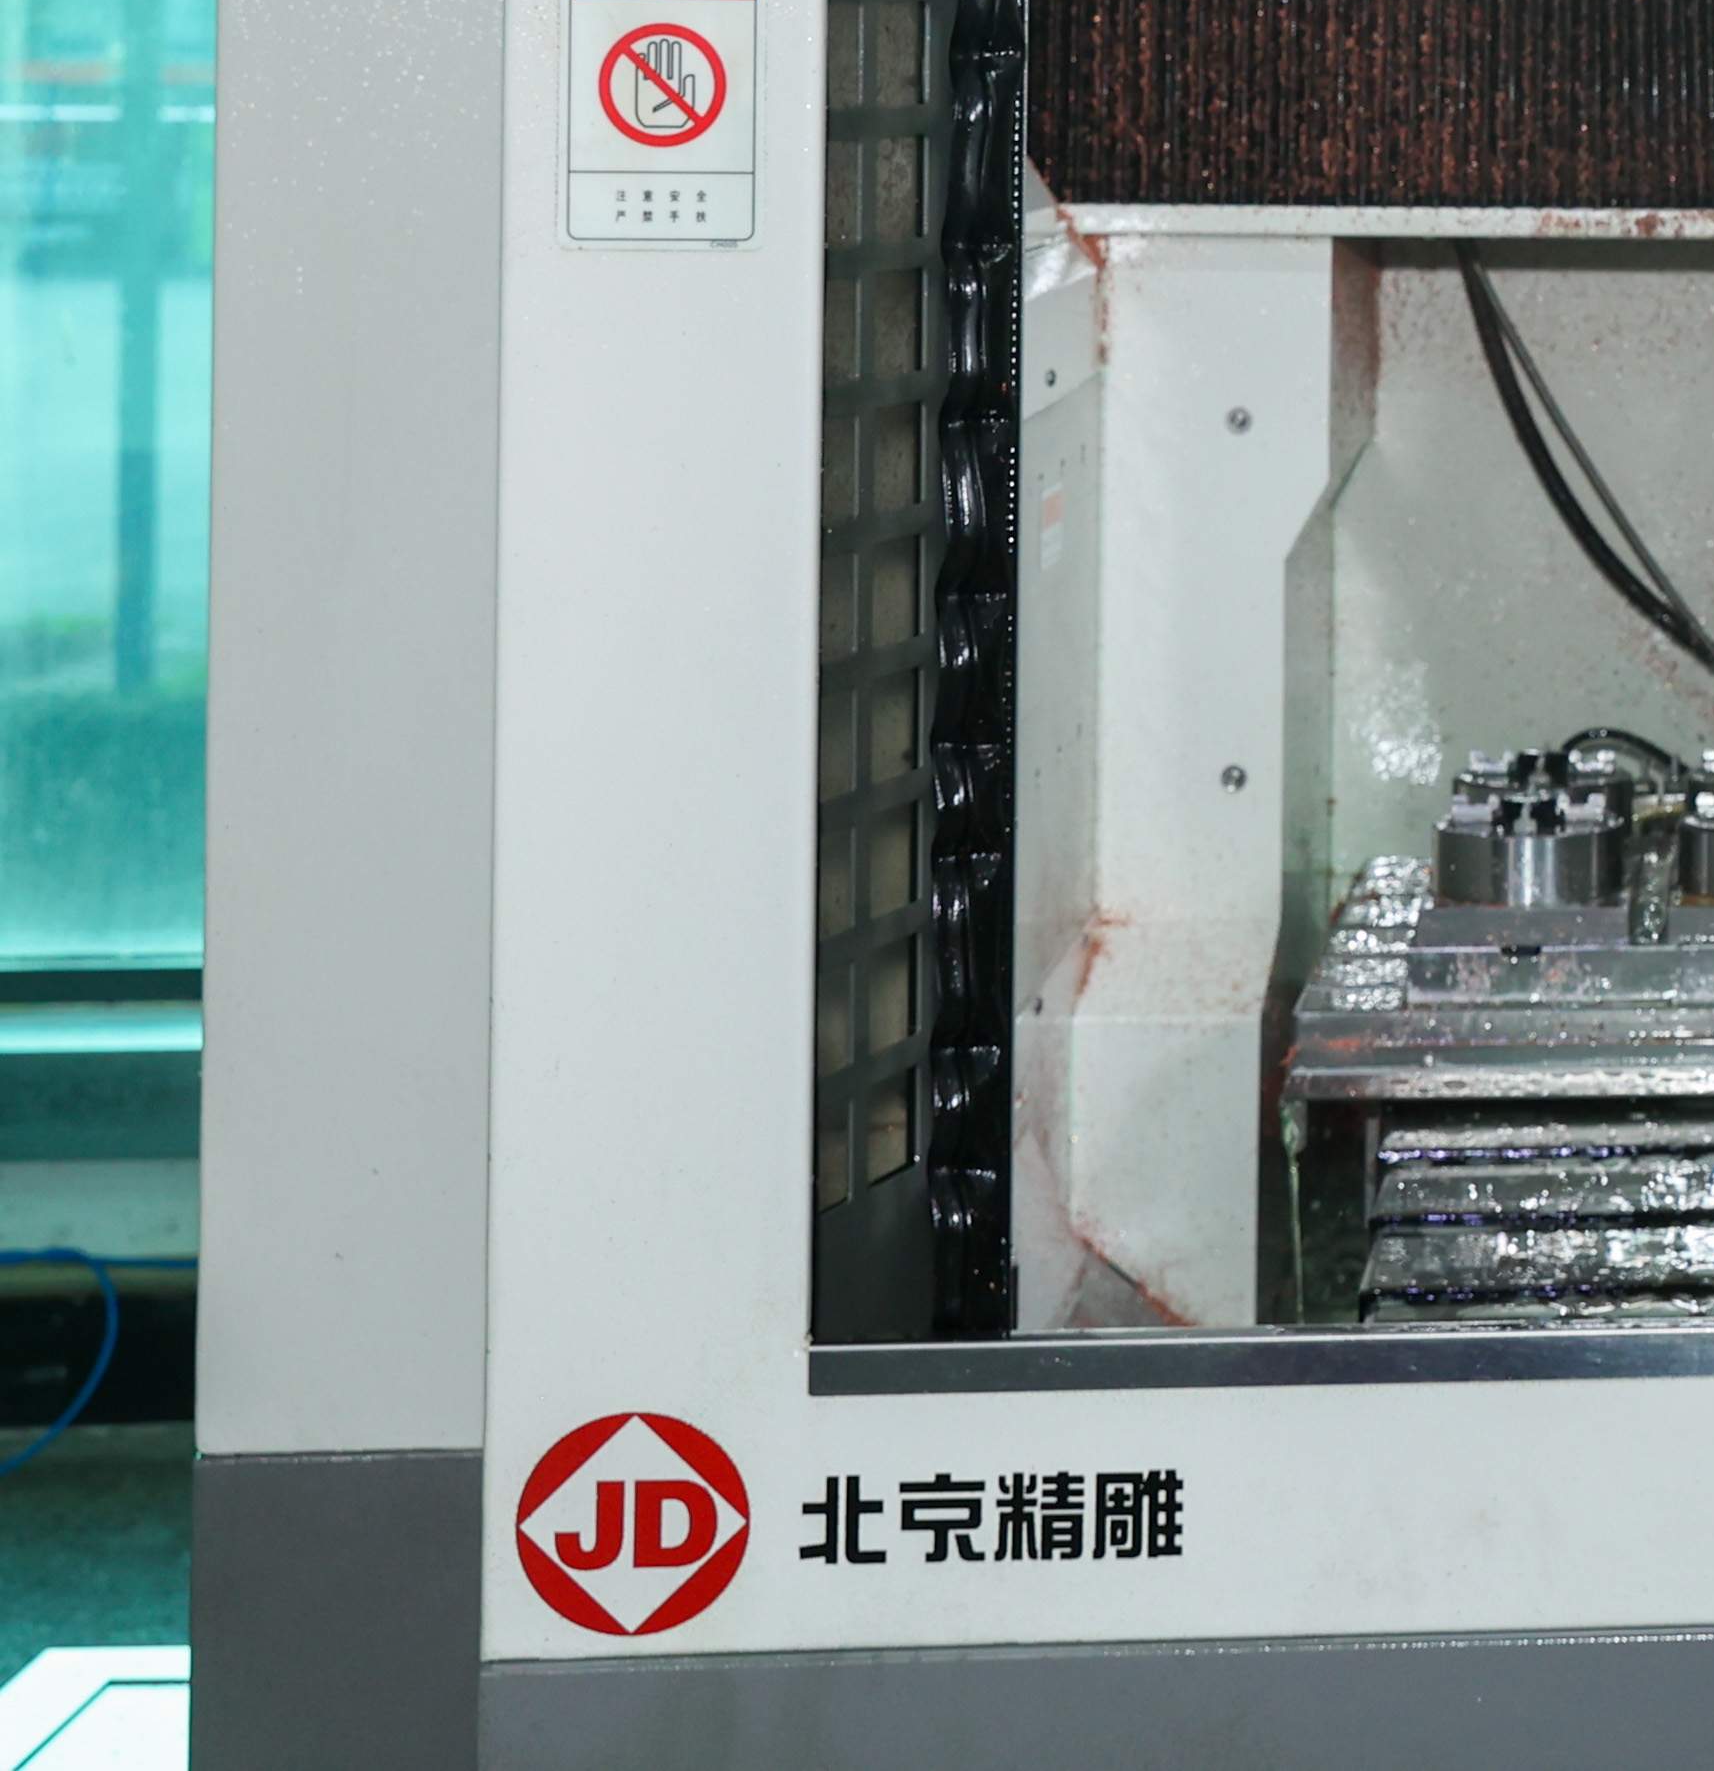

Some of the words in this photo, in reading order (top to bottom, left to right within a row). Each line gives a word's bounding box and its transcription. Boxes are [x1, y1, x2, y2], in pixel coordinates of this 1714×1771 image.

[555, 1479, 719, 1571] JD
[799, 1470, 1184, 1564] 北京精雕
